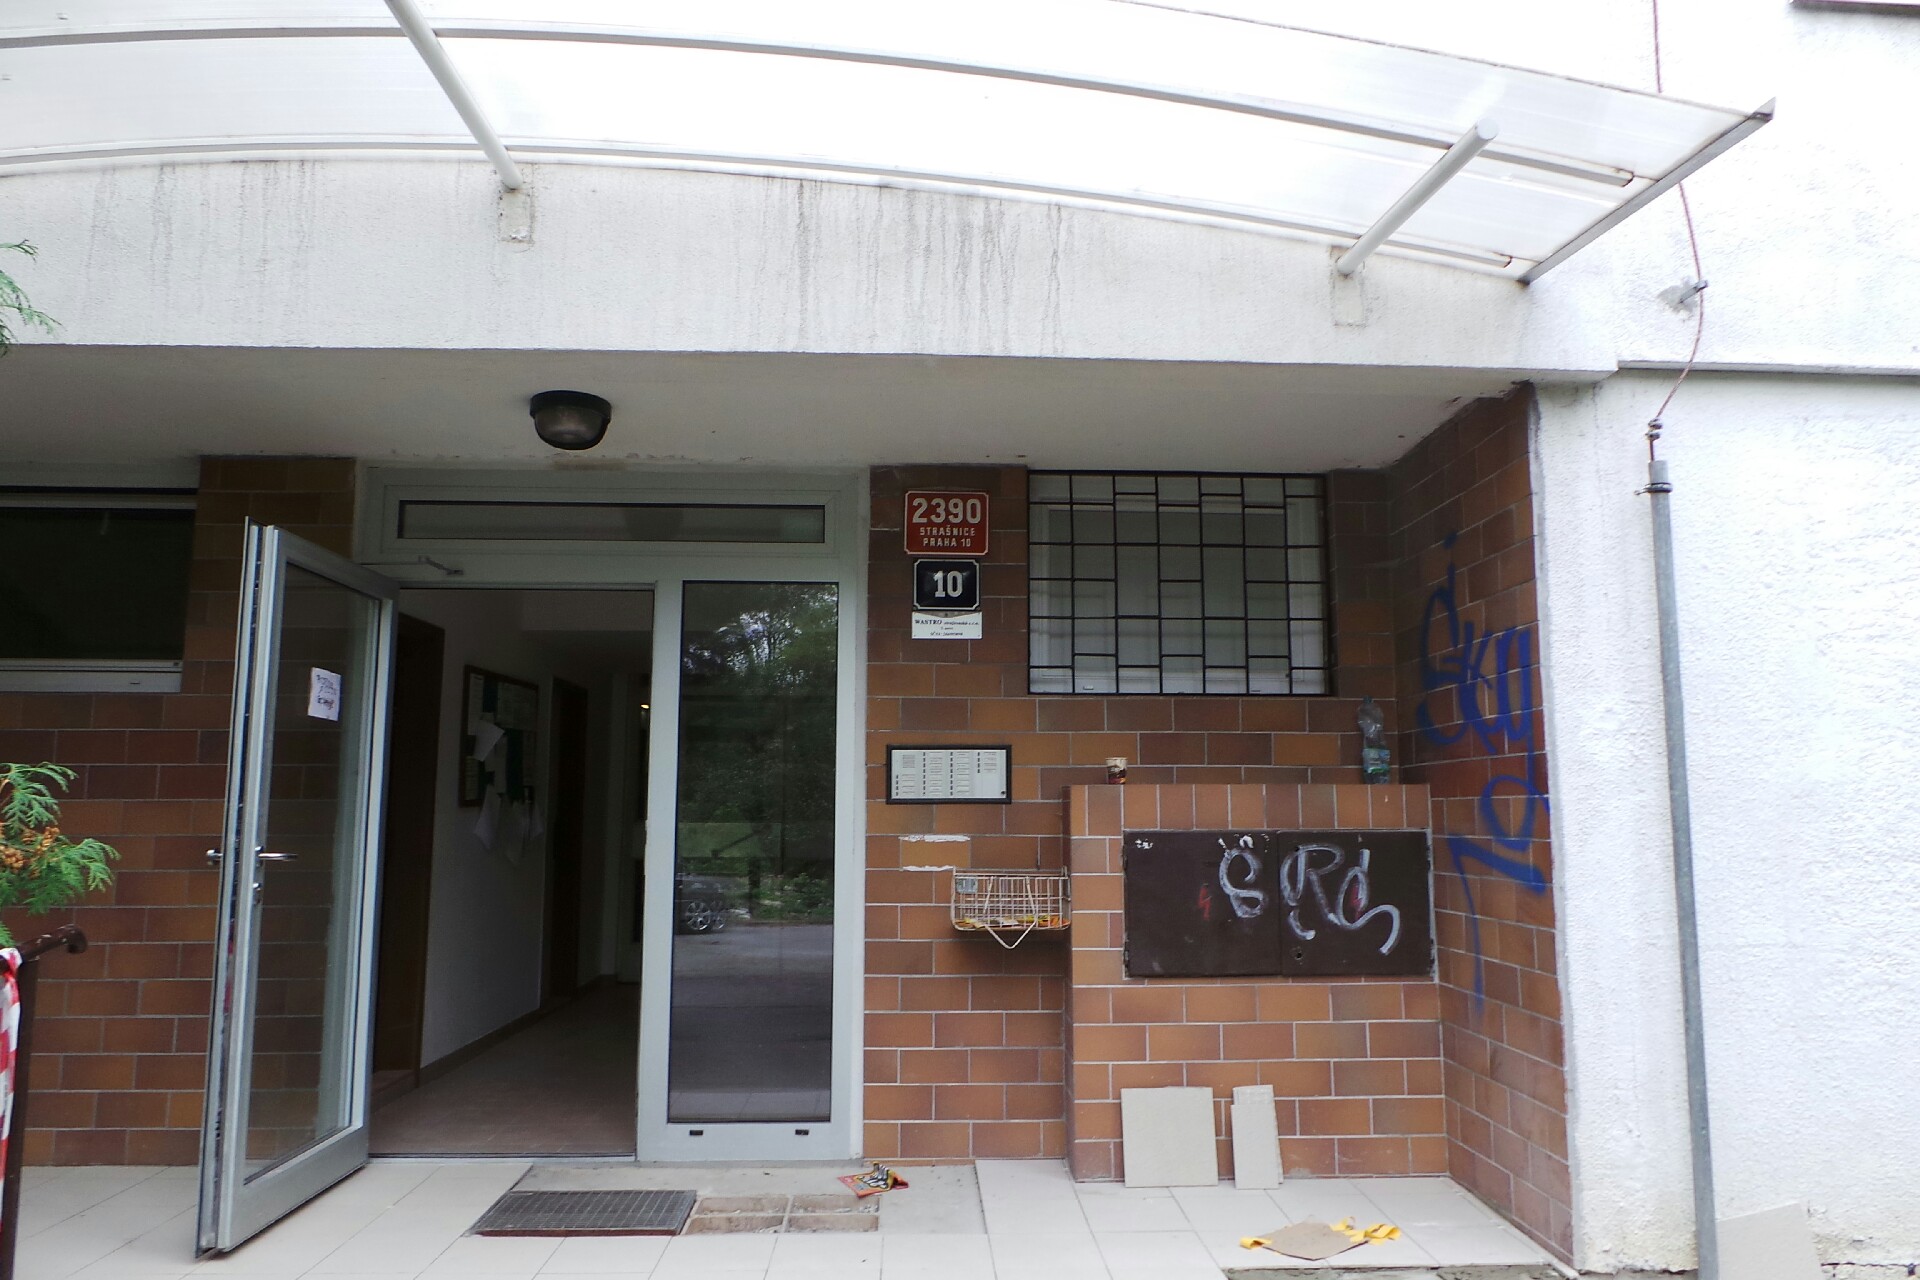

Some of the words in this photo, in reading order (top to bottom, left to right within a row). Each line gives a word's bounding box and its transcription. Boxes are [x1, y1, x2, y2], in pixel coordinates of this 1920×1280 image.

[912, 497, 981, 523] 2390
[919, 525, 975, 536] STRAŠNICE
[923, 538, 957, 547] PRAHA
[961, 538, 971, 547] 10
[933, 570, 963, 597] 10
